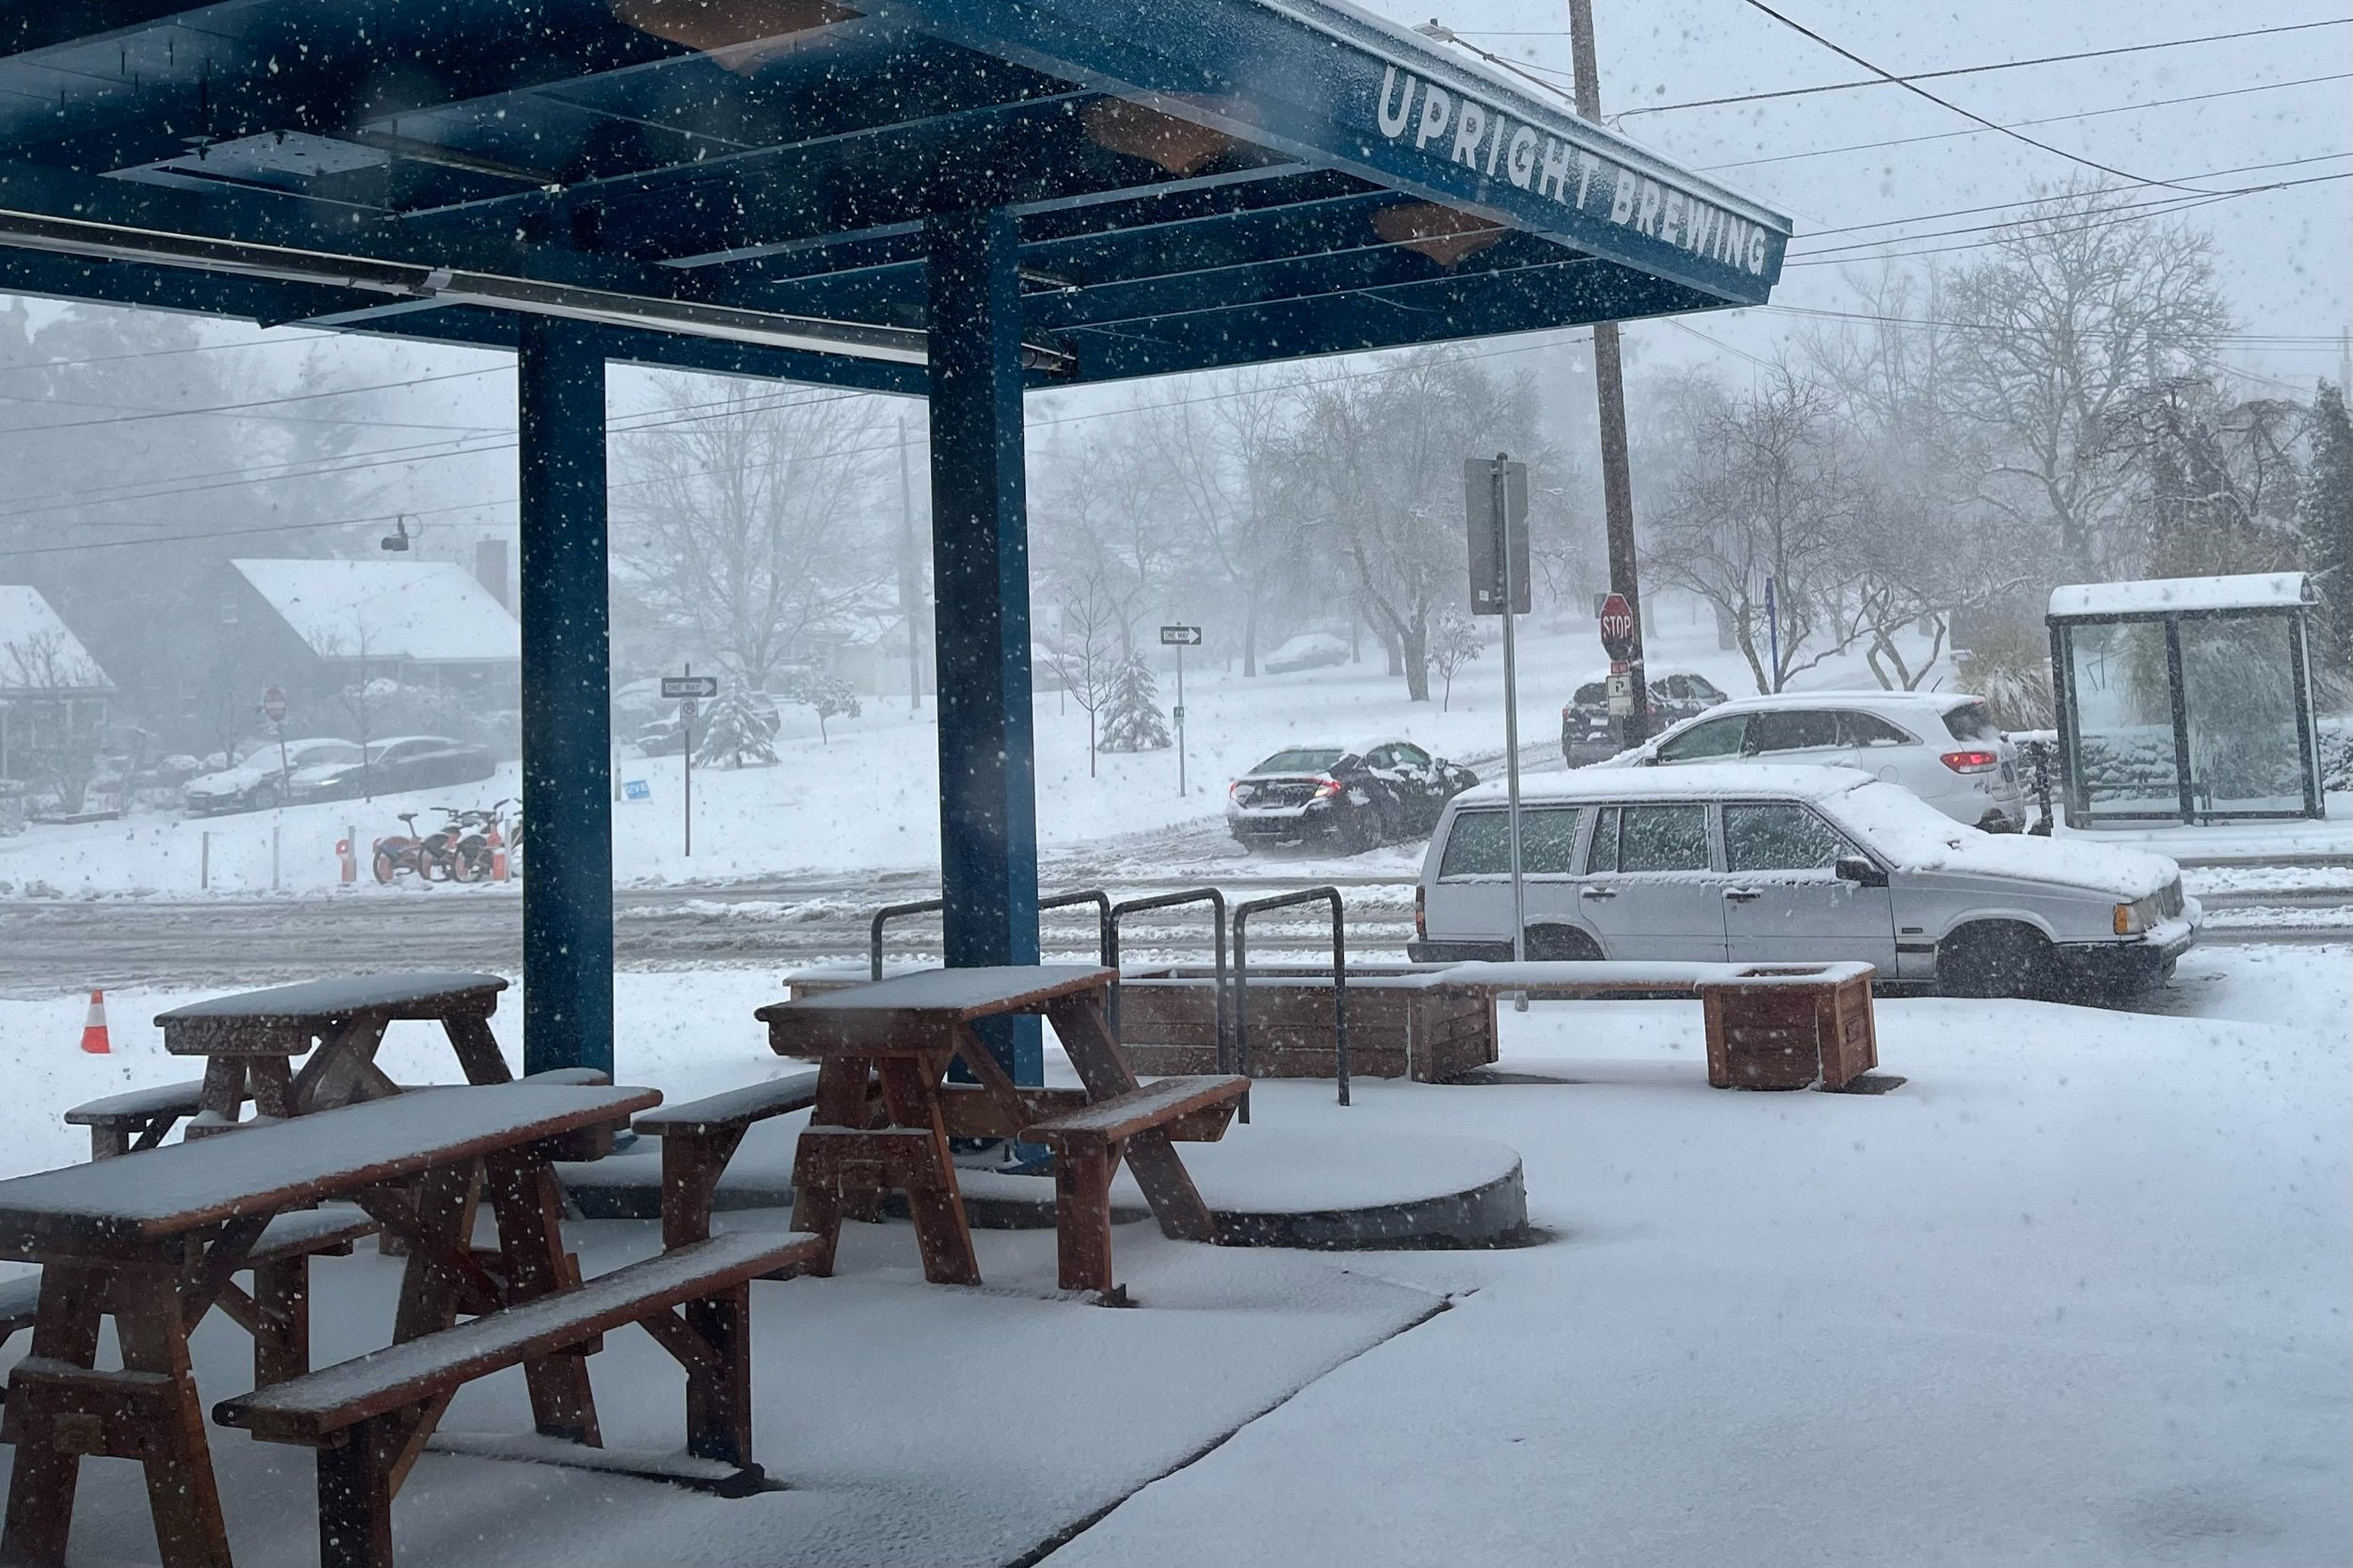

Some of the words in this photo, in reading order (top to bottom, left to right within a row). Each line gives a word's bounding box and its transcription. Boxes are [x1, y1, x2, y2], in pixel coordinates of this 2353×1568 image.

[1377, 65, 1599, 210] UPRIGHT
[1609, 171, 1767, 276] BREWING
[1603, 616, 1631, 639] STOP
[1164, 632, 1176, 640] ONE
[666, 683, 681, 692] ONE
